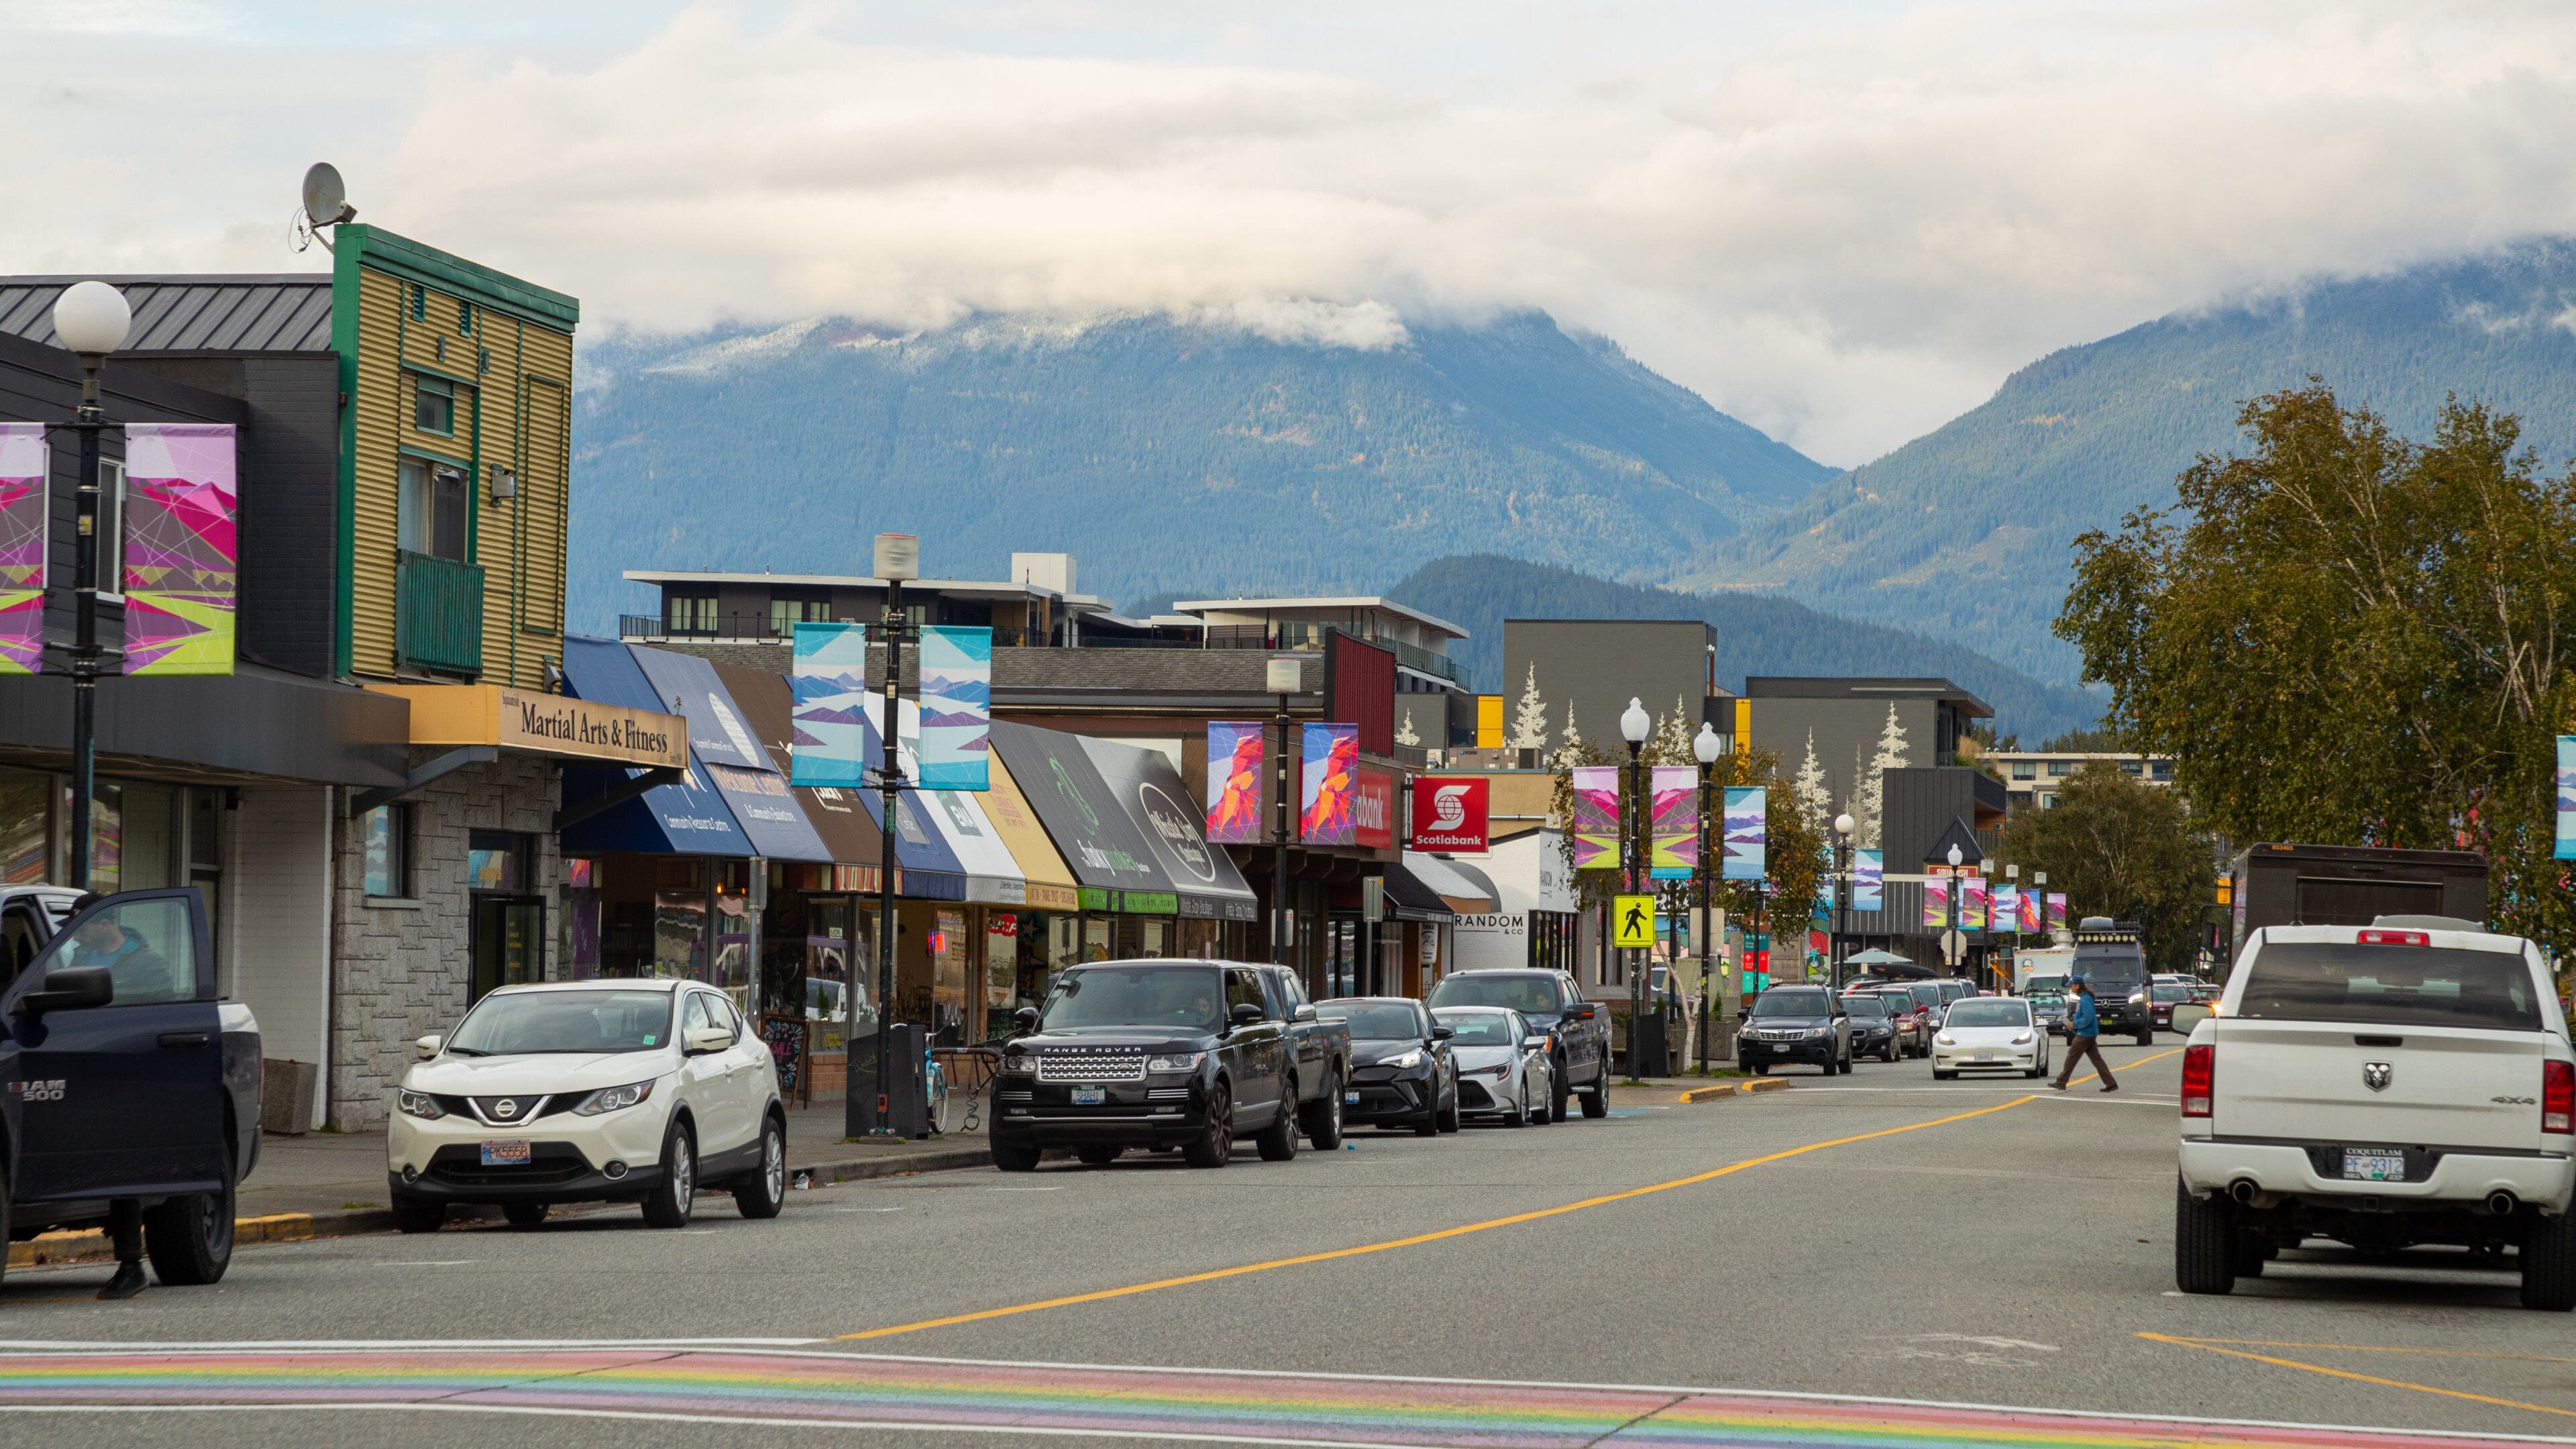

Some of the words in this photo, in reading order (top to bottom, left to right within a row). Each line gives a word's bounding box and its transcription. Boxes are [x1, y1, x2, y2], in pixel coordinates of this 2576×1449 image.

[521, 702, 575, 741] Martial
[578, 712, 608, 745] Arts
[611, 719, 622, 747] &
[624, 719, 667, 753] Fitness
[708, 764, 761, 794] Welcome
[752, 771, 790, 798] Centre
[664, 814, 696, 833] Community
[710, 817, 731, 833] Centre
[1416, 835, 1481, 845] Scotiabank
[1454, 914, 1523, 927] RANDOM
[771, 1042, 792, 1055] SALE
[2346, 1147, 2403, 1157] COQUITLAM
[2369, 1158, 2403, 1173] 9312
